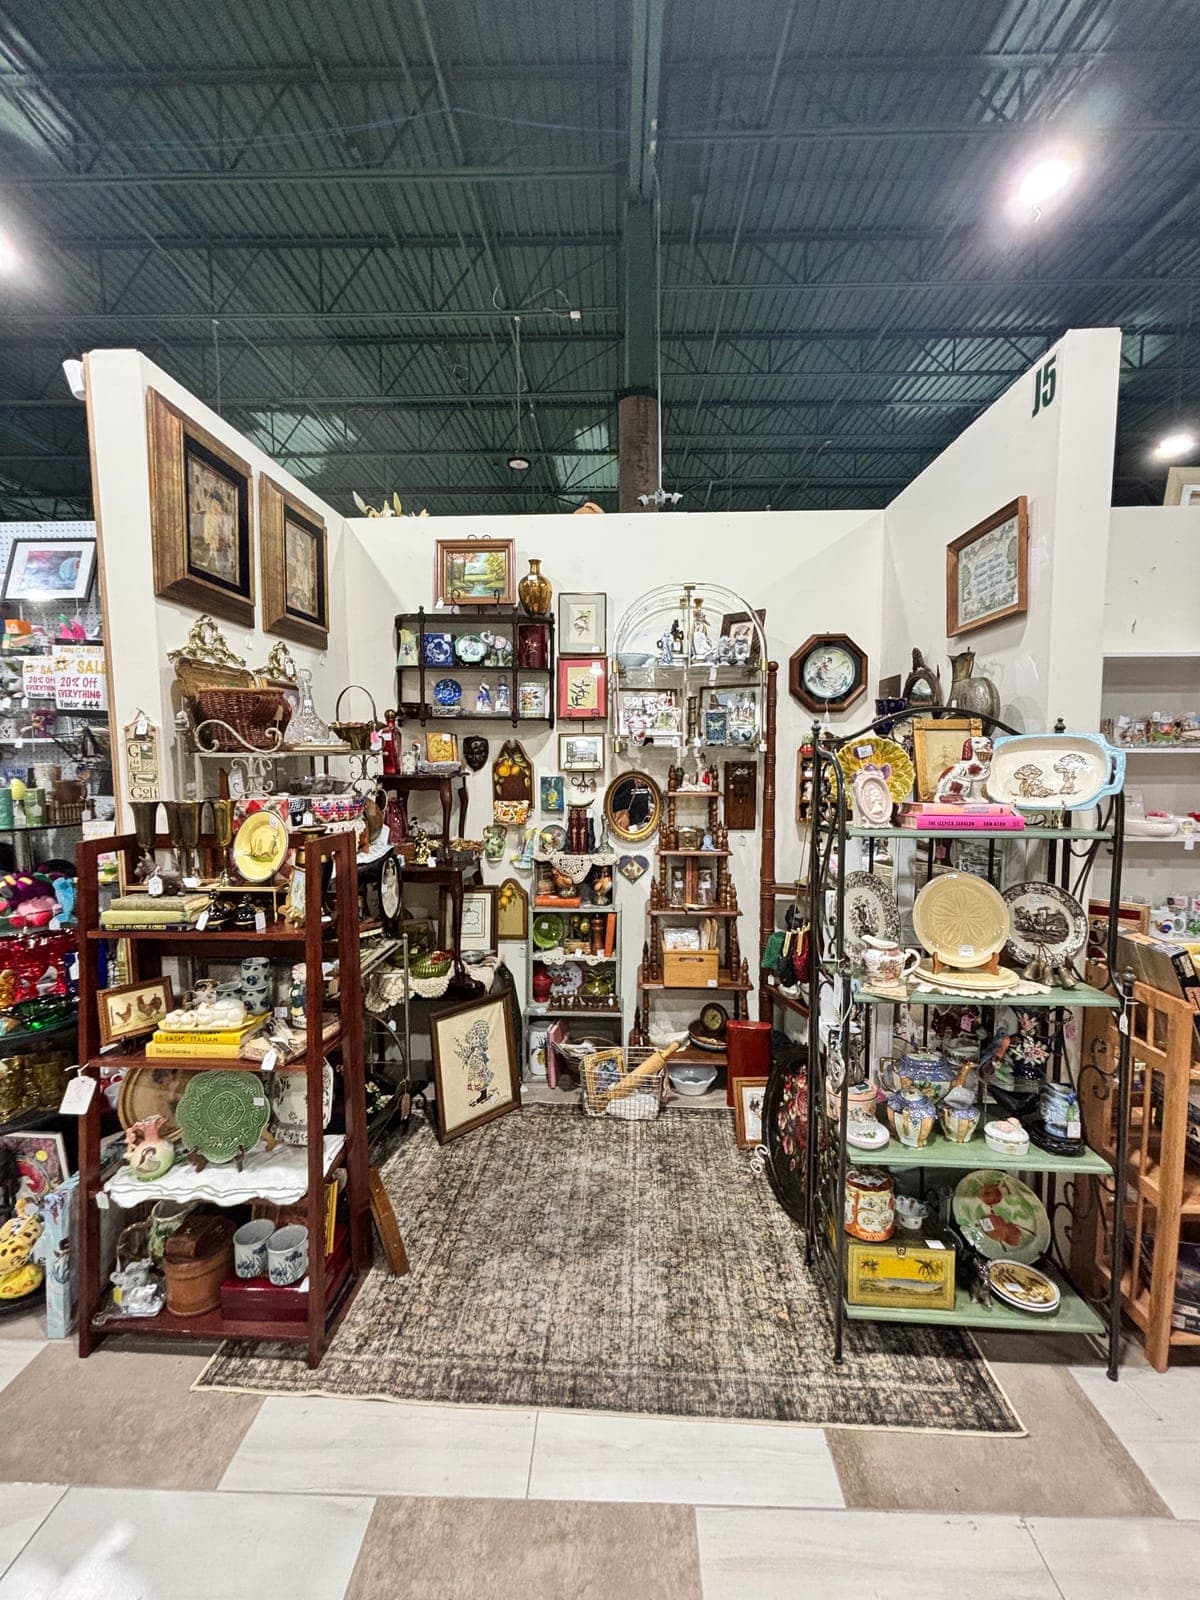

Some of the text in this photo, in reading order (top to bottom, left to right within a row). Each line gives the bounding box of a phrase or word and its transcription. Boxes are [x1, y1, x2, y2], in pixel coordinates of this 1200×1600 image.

[1032, 354, 1056, 417] J5
[28, 675, 44, 684] 20%
[60, 676, 98, 688] 20% Off
[58, 689, 102, 699] EVERYTHING
[81, 699, 101, 709] 444
[128, 744, 139, 758] G
[165, 1035, 185, 1043] BASIC
